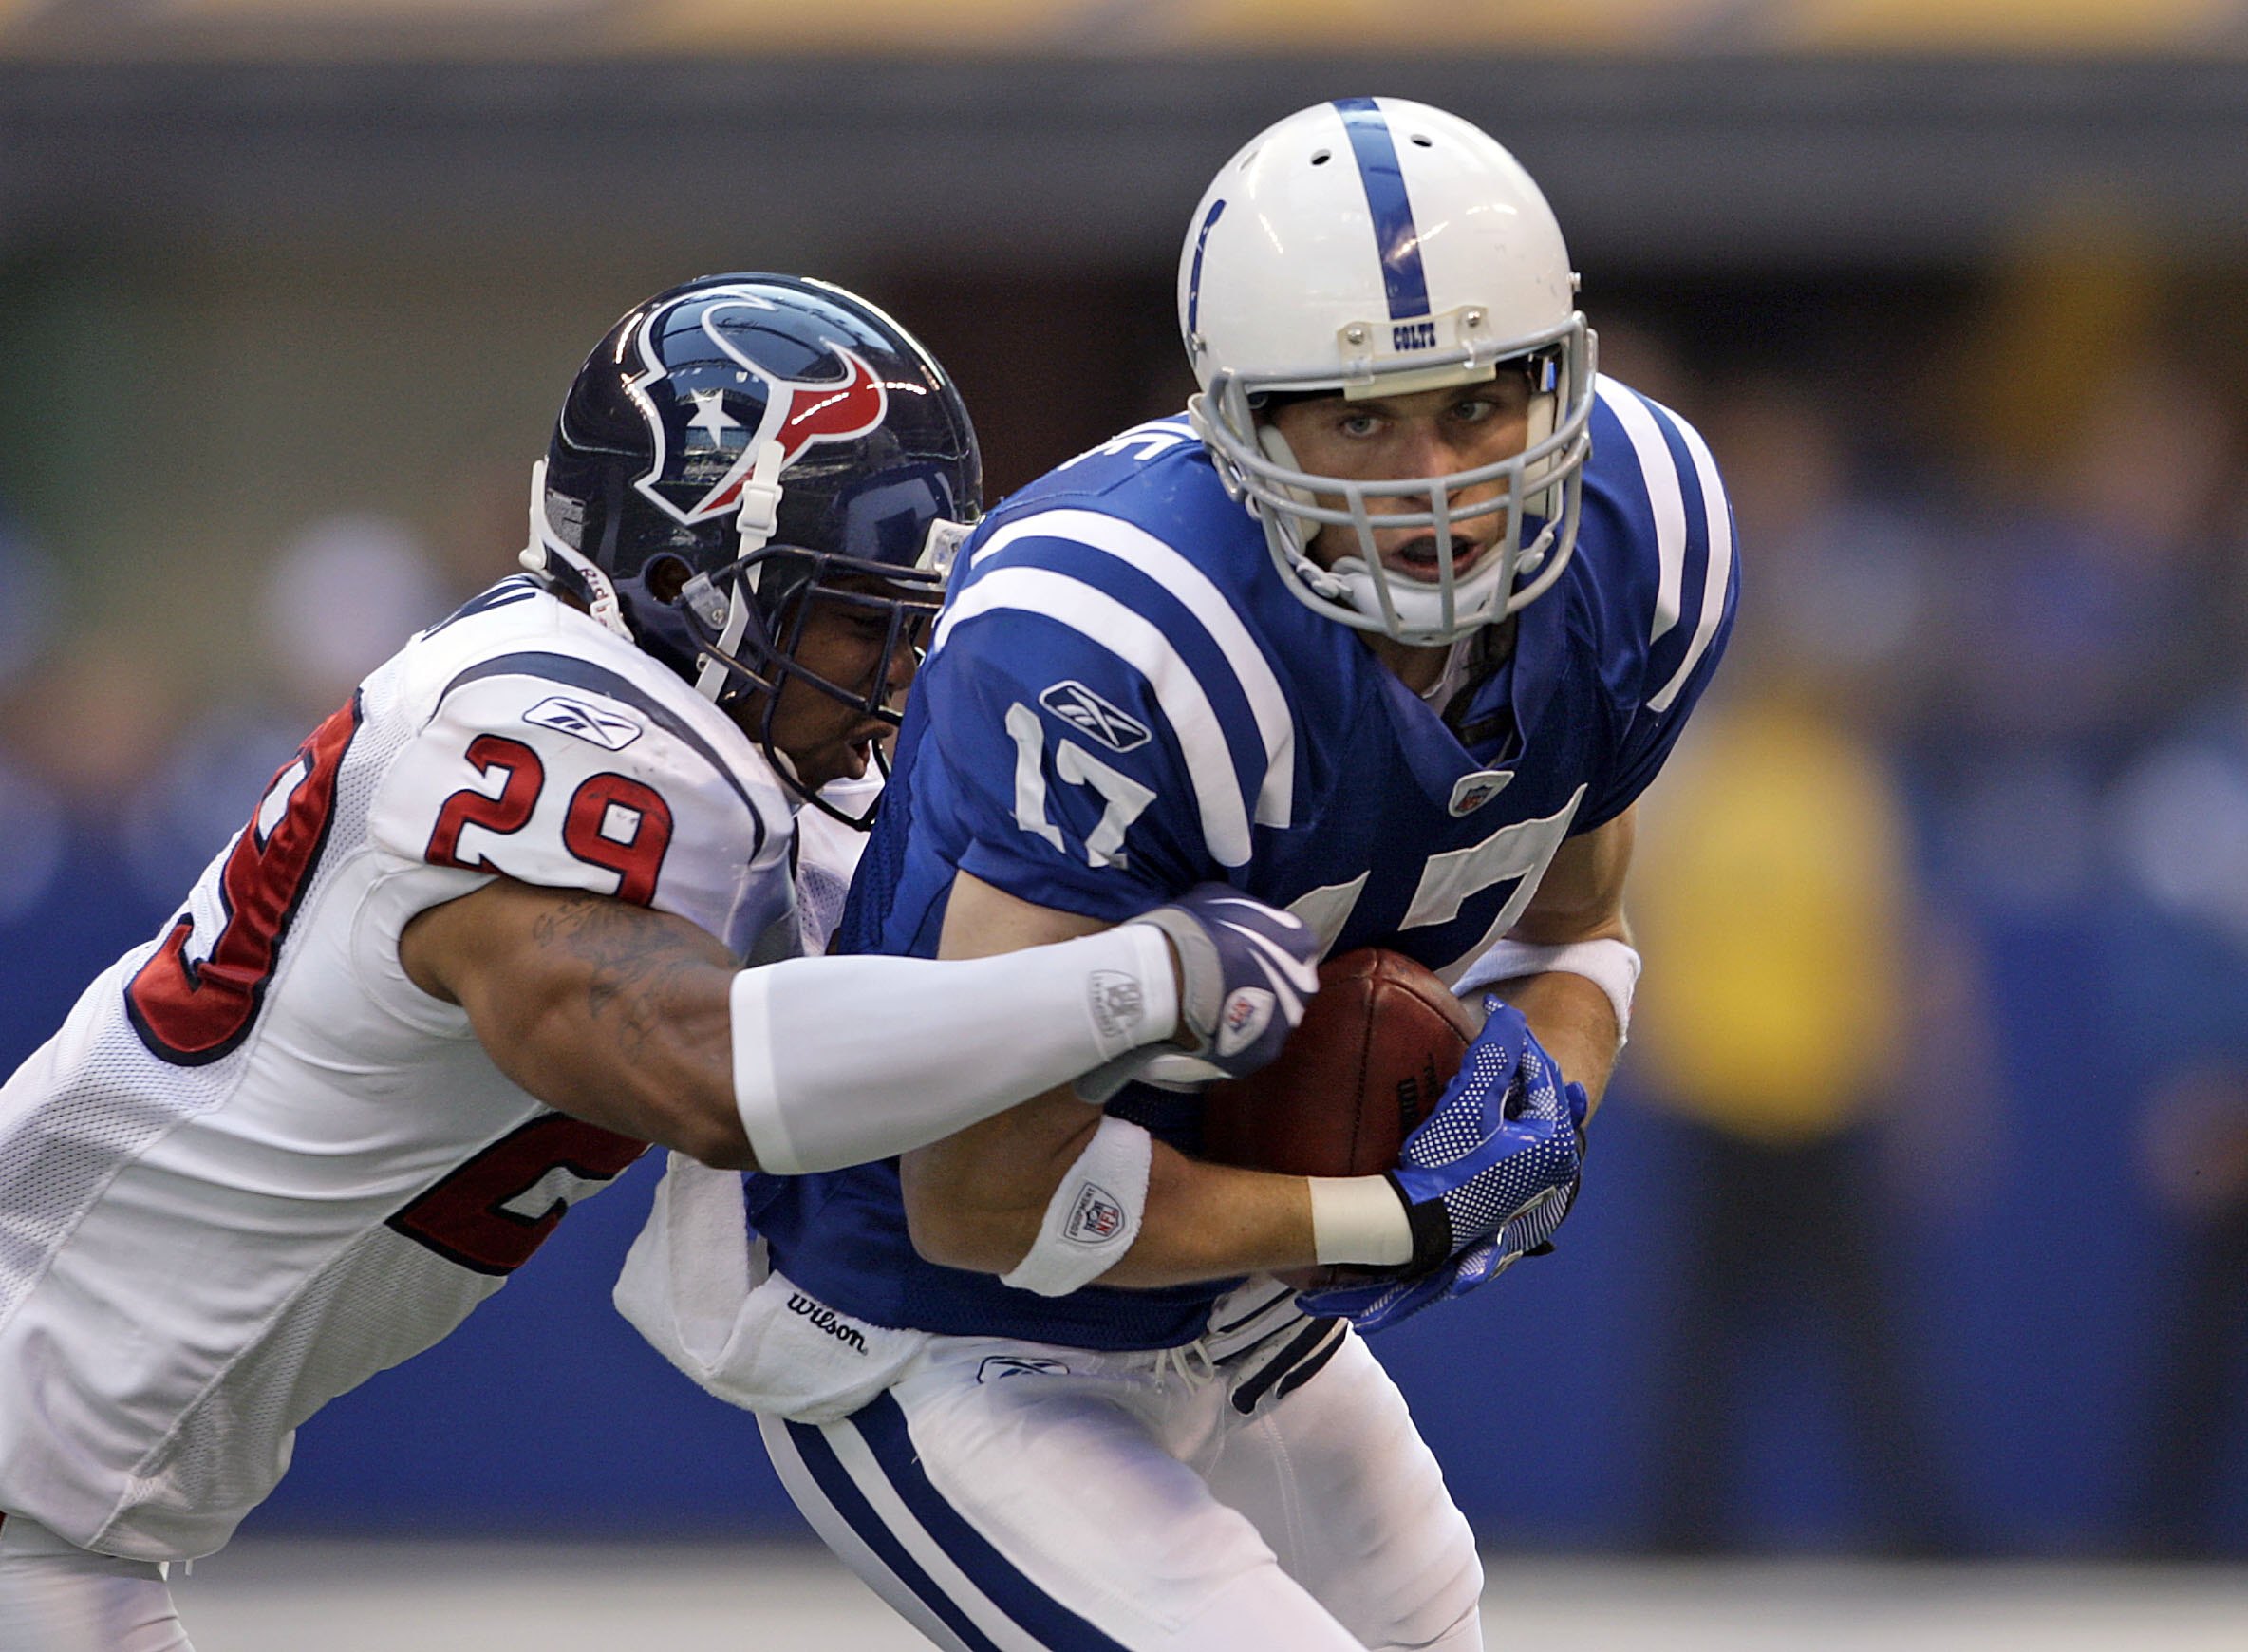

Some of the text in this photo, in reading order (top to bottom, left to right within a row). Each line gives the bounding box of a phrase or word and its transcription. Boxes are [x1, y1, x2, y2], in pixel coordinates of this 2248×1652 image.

[1393, 322, 1436, 351] COLTS
[424, 733, 675, 909] 29
[1004, 702, 1158, 868] 17
